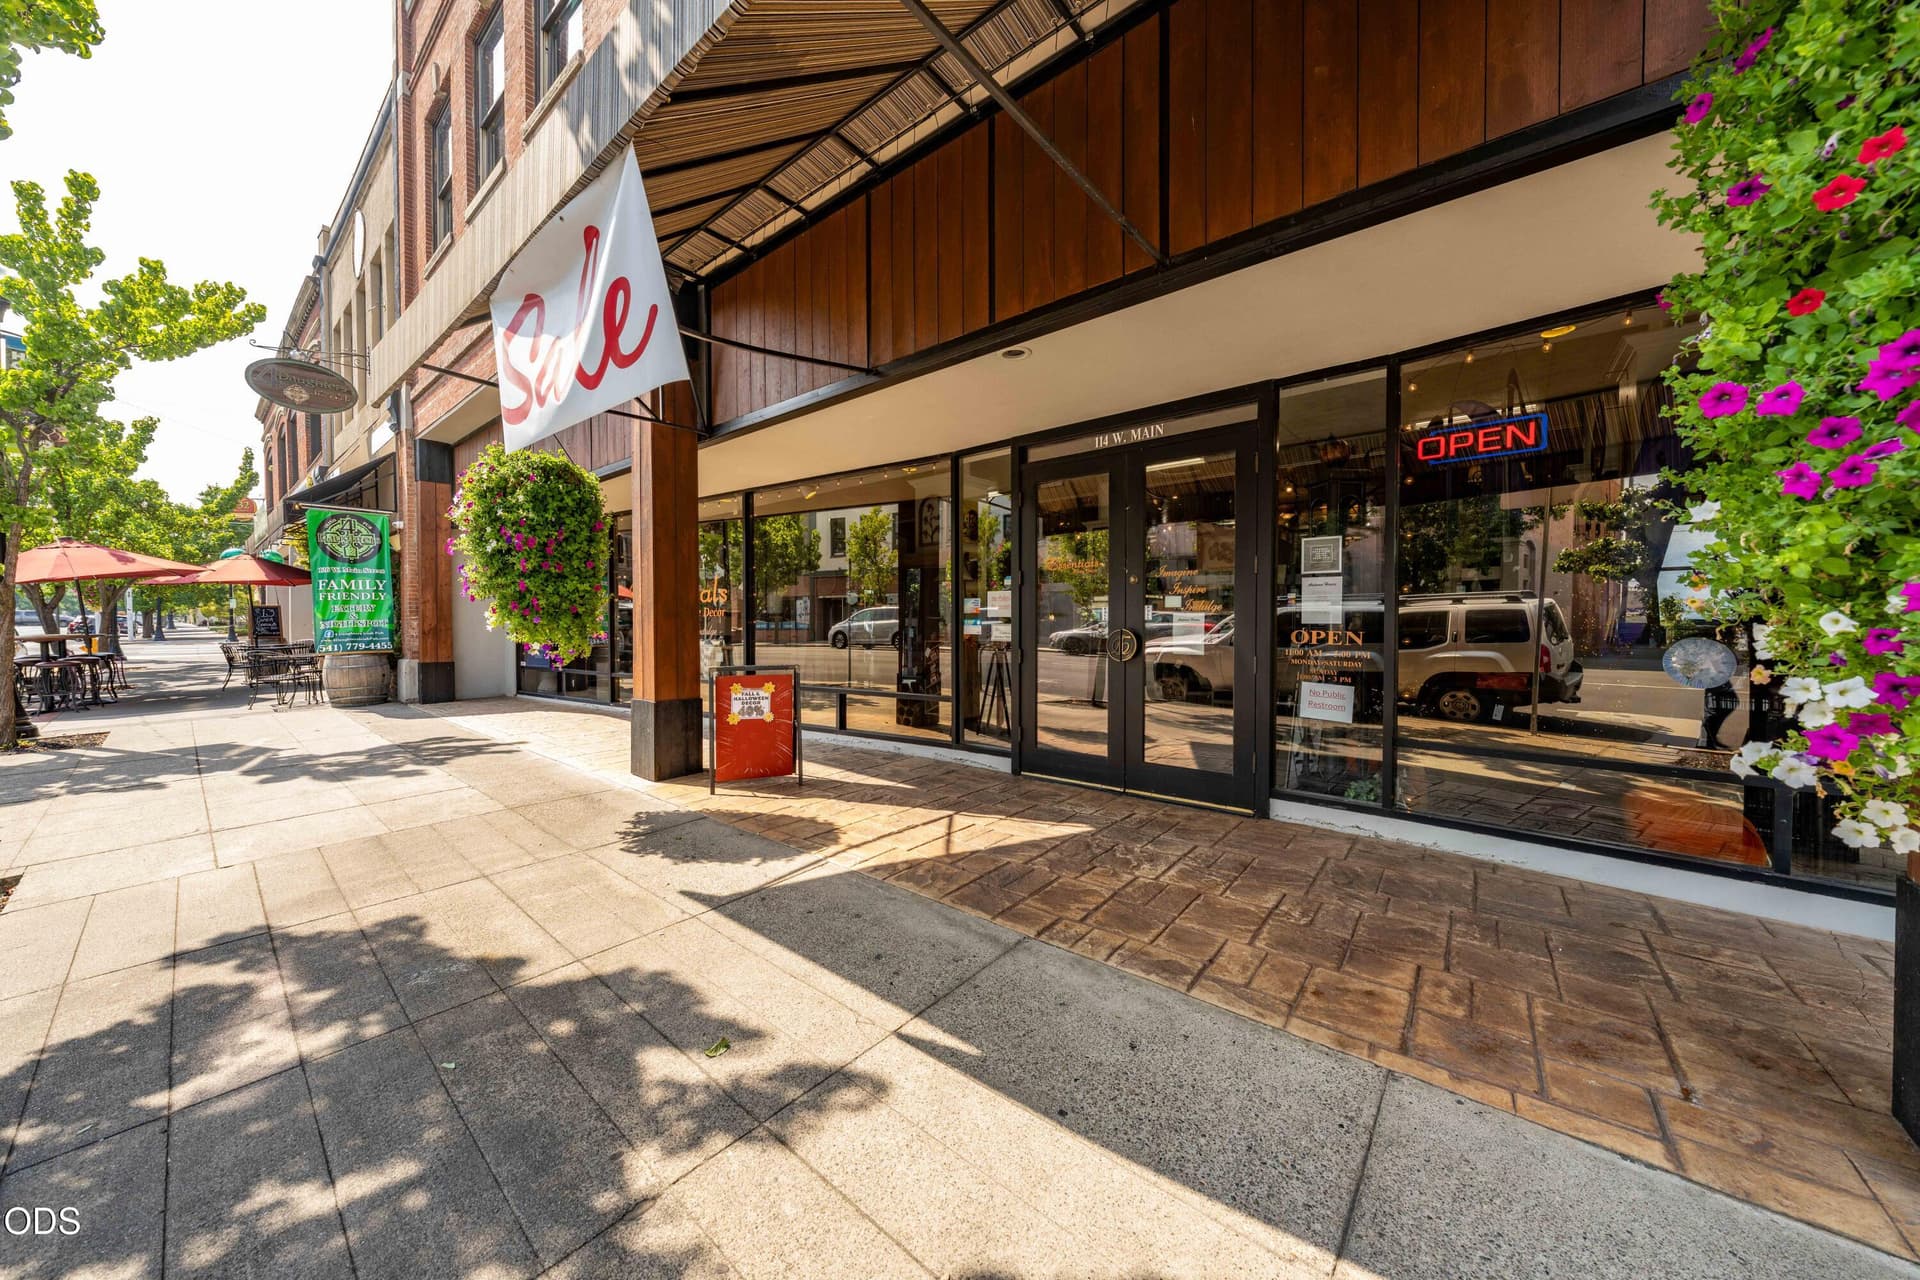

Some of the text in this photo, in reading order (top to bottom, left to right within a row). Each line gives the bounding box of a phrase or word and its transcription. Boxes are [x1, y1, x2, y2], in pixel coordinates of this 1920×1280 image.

[501, 224, 659, 426] Sale
[1095, 423, 1165, 449] 114 W. MAIN
[1417, 420, 1537, 461] OPEN
[1154, 564, 1200, 581] Imagine
[318, 579, 387, 591] FAMILY
[1168, 581, 1207, 598] Inspire
[318, 592, 387, 601] FRIENDLY
[1290, 629, 1364, 647] OPEN
[316, 640, 393, 654] (541) 779-4455
[1307, 649, 1323, 657] AM
[1309, 689, 1346, 700] No Public
[1307, 700, 1346, 712] Restroom
